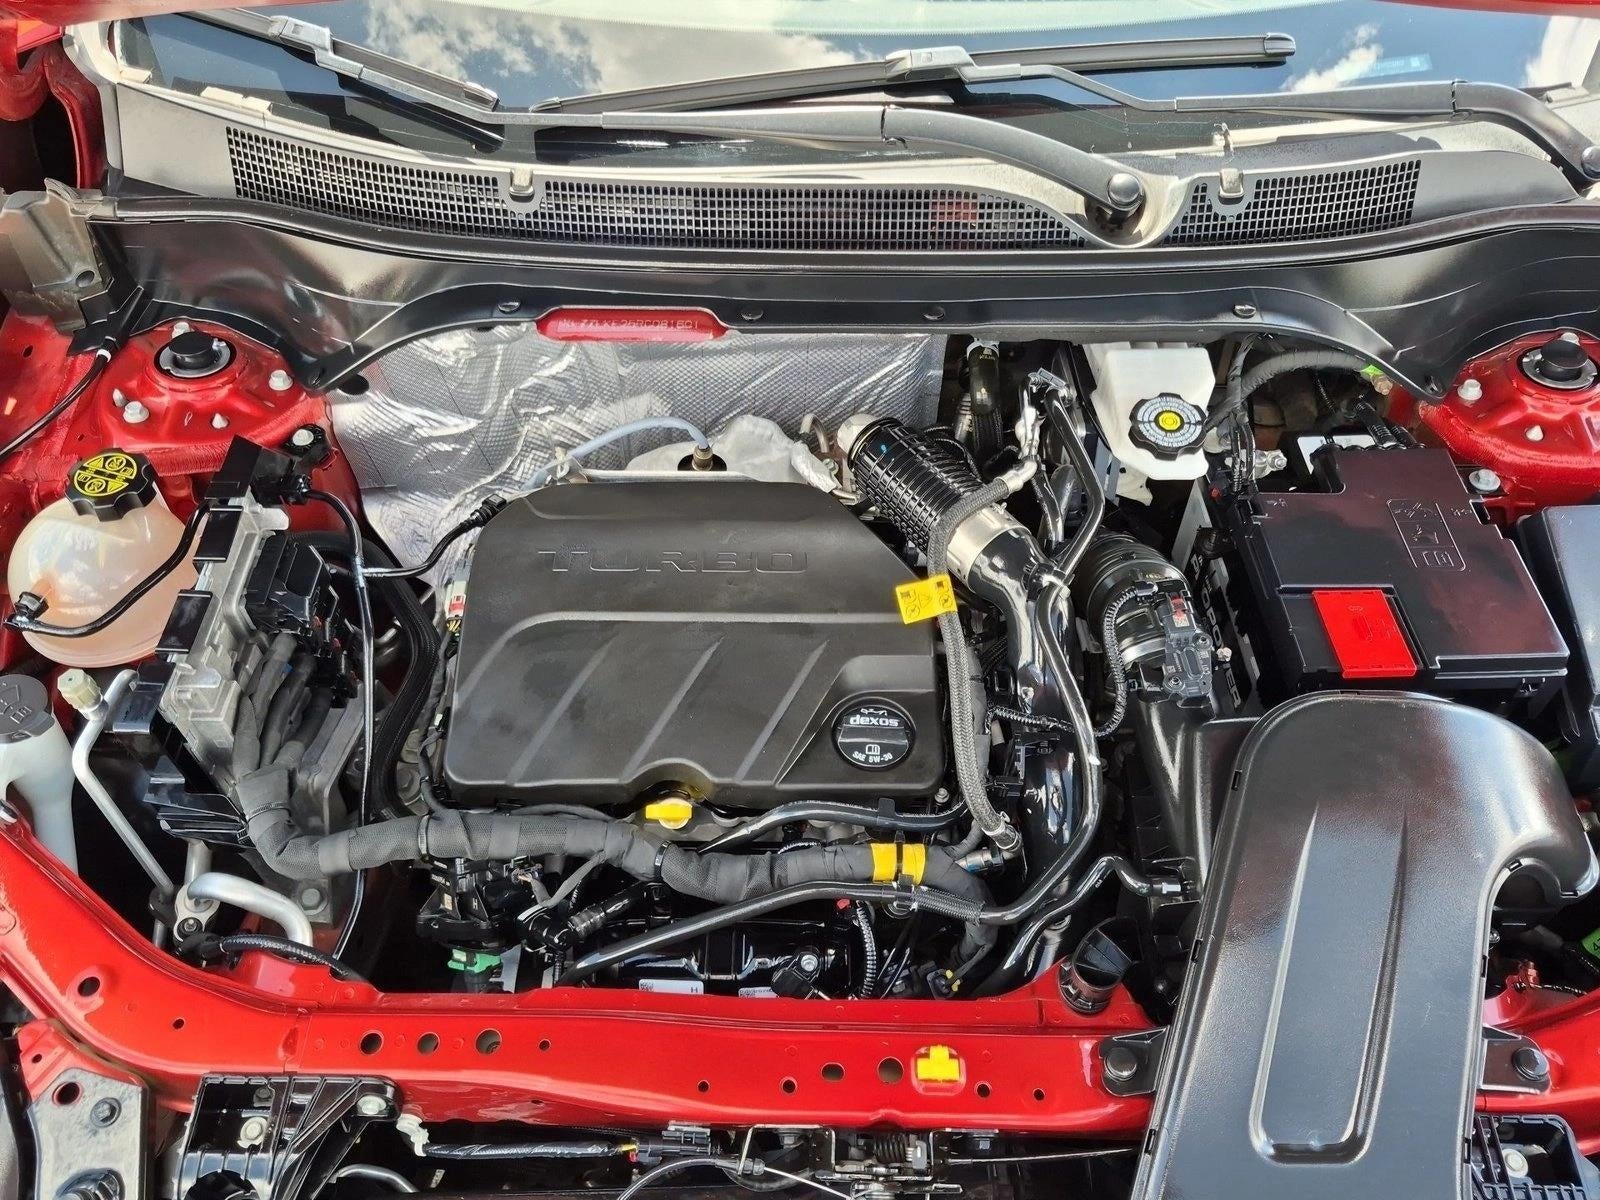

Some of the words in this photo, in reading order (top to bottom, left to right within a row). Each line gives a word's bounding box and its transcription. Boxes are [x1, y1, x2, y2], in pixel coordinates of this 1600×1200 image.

[537, 551, 807, 573] TURBO
[849, 714, 900, 727] dexos
[852, 751, 866, 762] SAE
[868, 752, 893, 763] 5W-30
